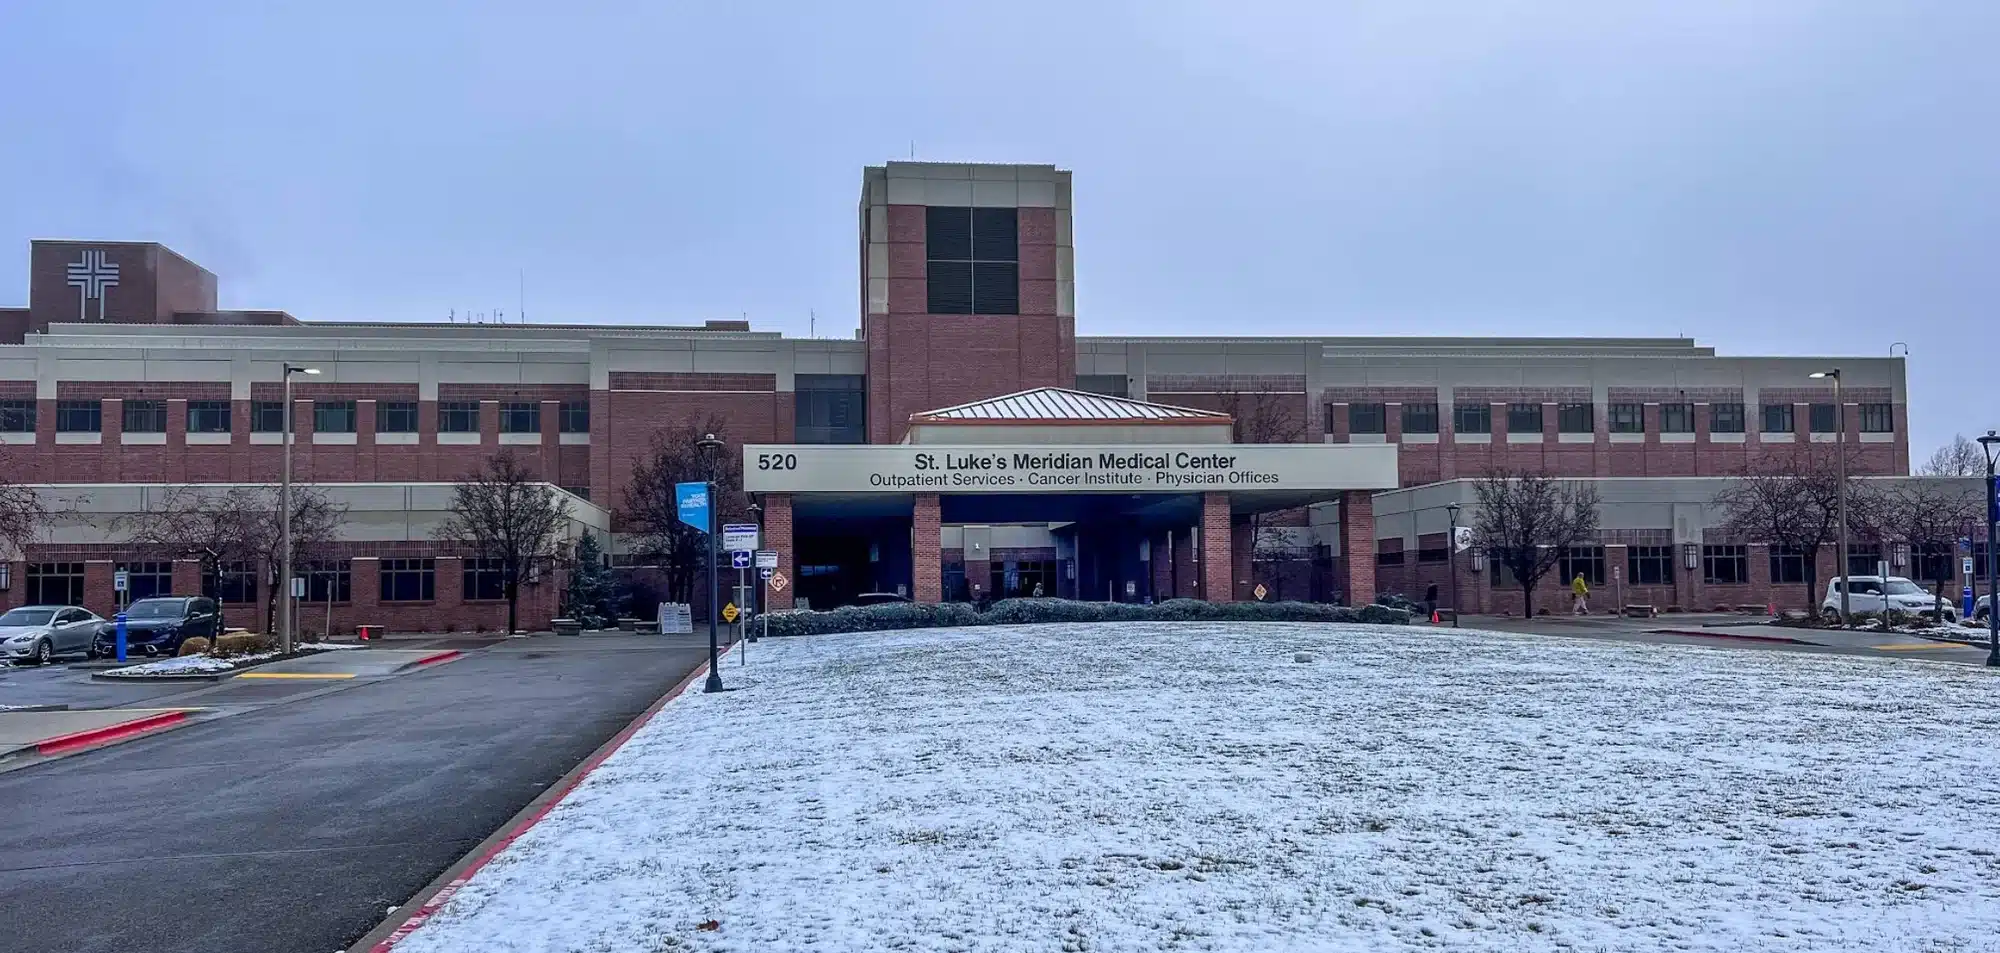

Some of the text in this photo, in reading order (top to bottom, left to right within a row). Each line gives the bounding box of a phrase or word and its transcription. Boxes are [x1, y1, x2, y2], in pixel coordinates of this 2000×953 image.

[758, 453, 797, 471] 520
[914, 452, 1237, 470] St. Luke's Meridian Medical Center
[870, 471, 1280, 488] Outpatient Services Cancer Institute Physician Offices
